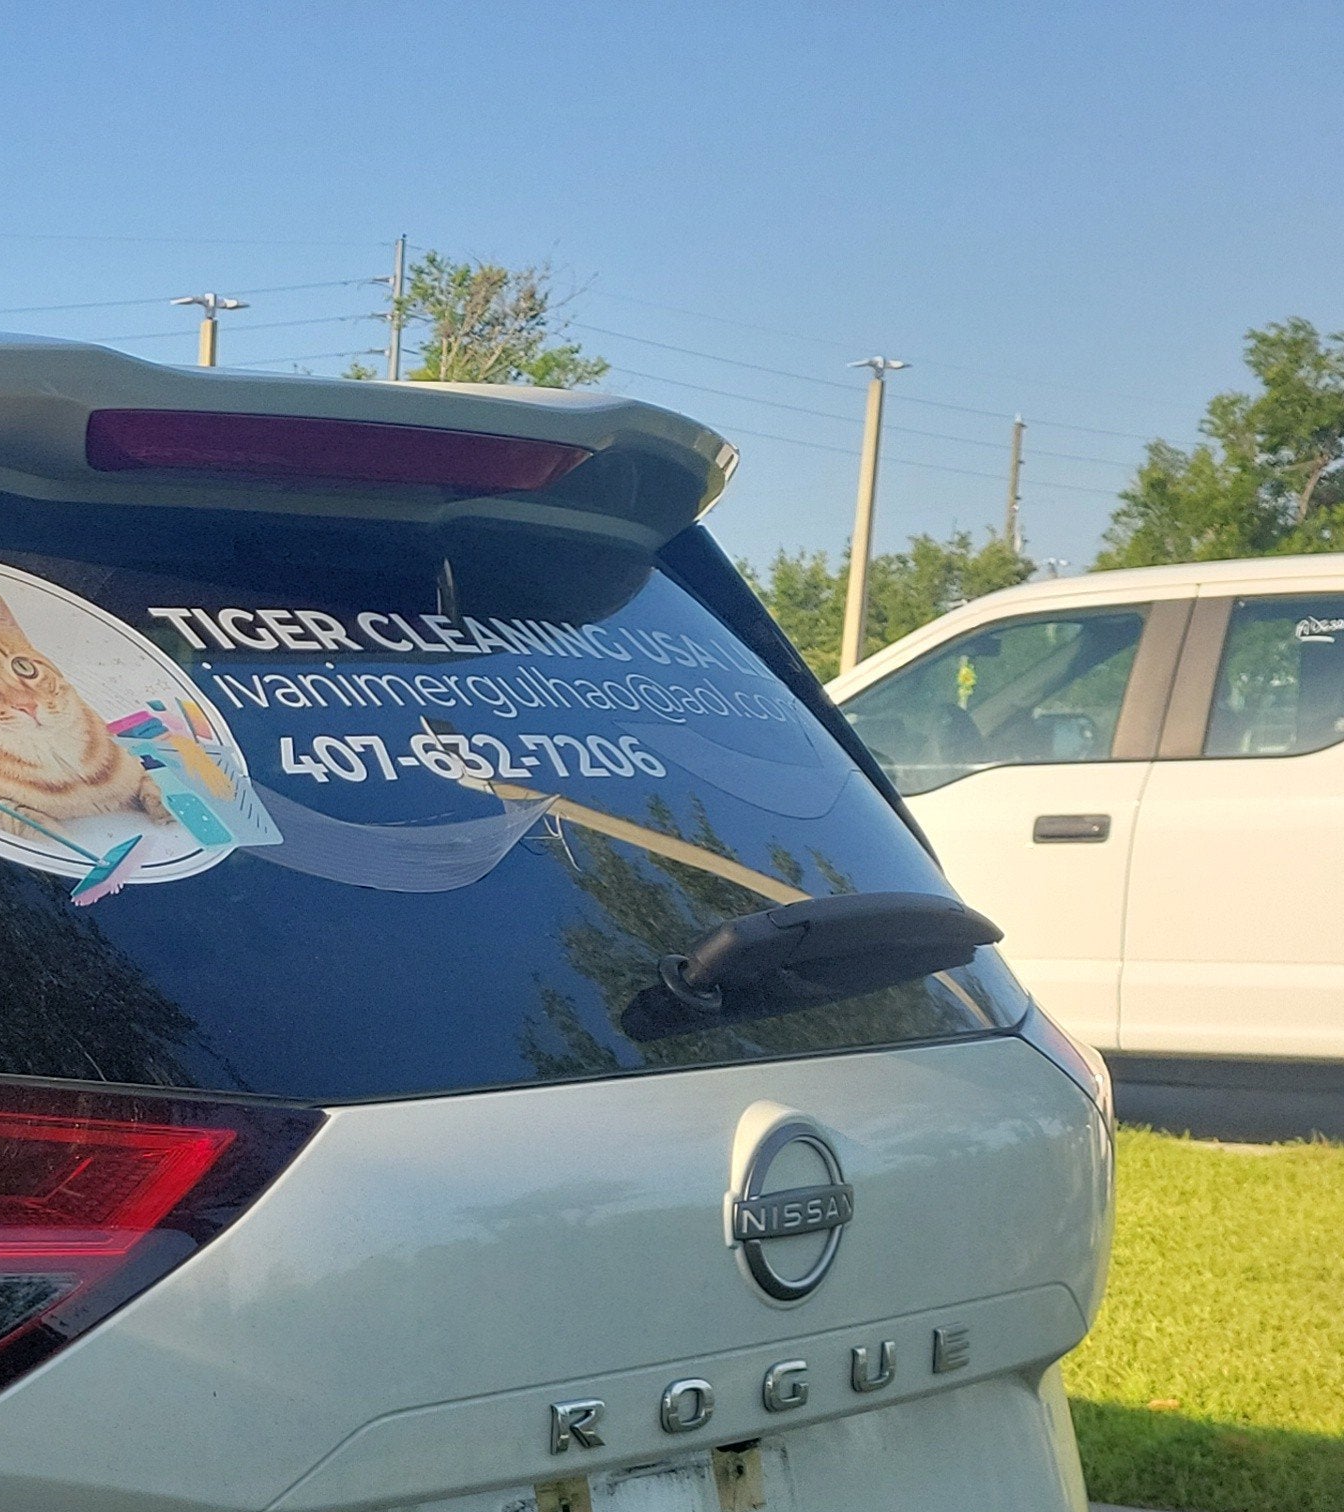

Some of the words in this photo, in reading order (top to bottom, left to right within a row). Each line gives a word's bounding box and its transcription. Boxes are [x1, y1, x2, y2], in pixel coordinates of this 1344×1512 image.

[147, 606, 365, 651] TIGER
[356, 610, 634, 663] CLEANING
[617, 626, 730, 672] USA
[709, 638, 776, 682] LL
[279, 733, 668, 783] 407-632-7206
[549, 1322, 972, 1456] ROGUE
